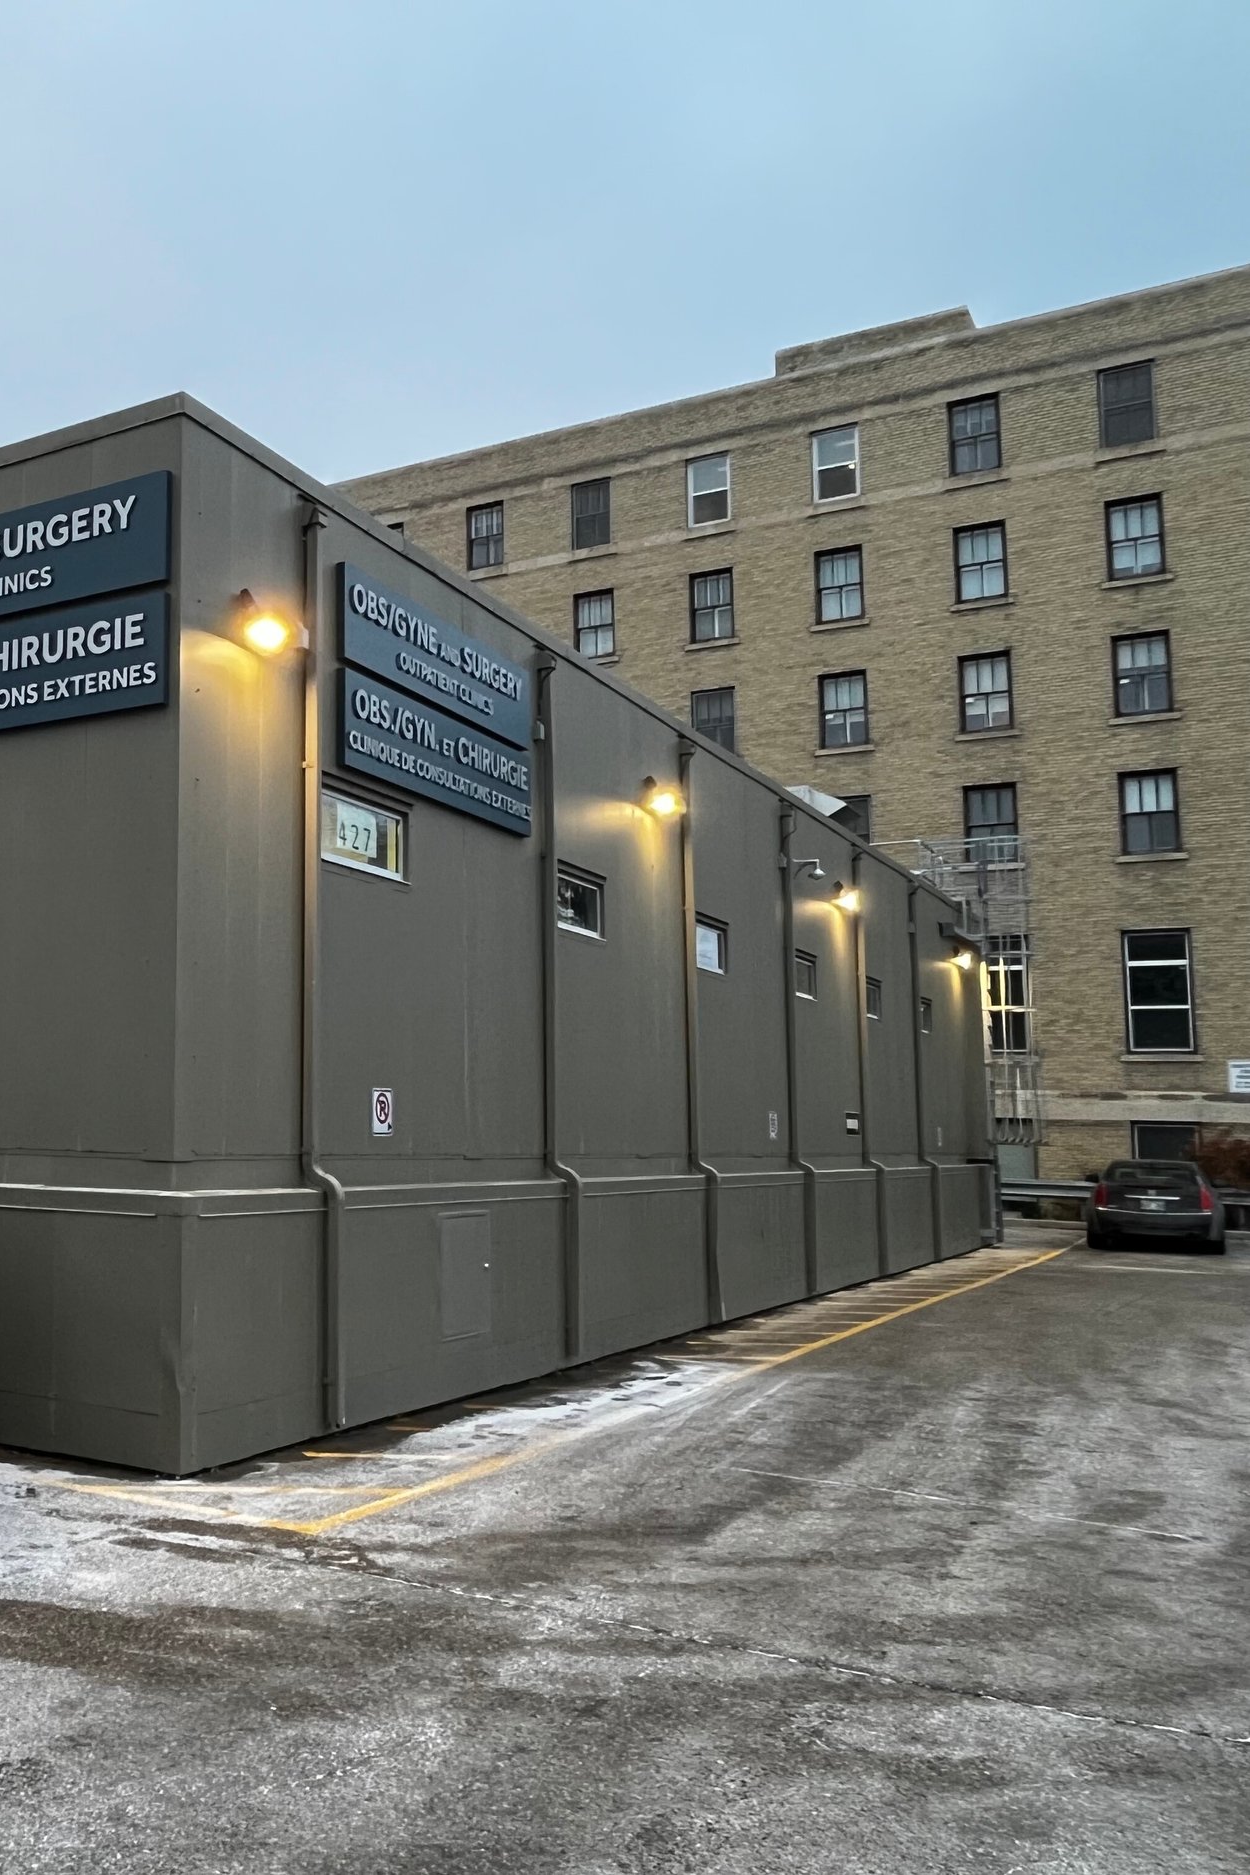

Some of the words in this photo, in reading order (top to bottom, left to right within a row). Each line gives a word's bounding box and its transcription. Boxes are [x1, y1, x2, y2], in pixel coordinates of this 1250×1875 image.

[353, 583, 437, 655] OBS/GYNE
[463, 646, 522, 700] SURGERY
[43, 661, 156, 701] EXTERNES
[350, 730, 400, 767] CLINIQUE
[402, 752, 416, 773] DE
[356, 688, 439, 750] OBS./GYN.
[443, 738, 456, 757] ET
[458, 737, 528, 790] CHIRURGIE
[338, 821, 371, 852] 427
